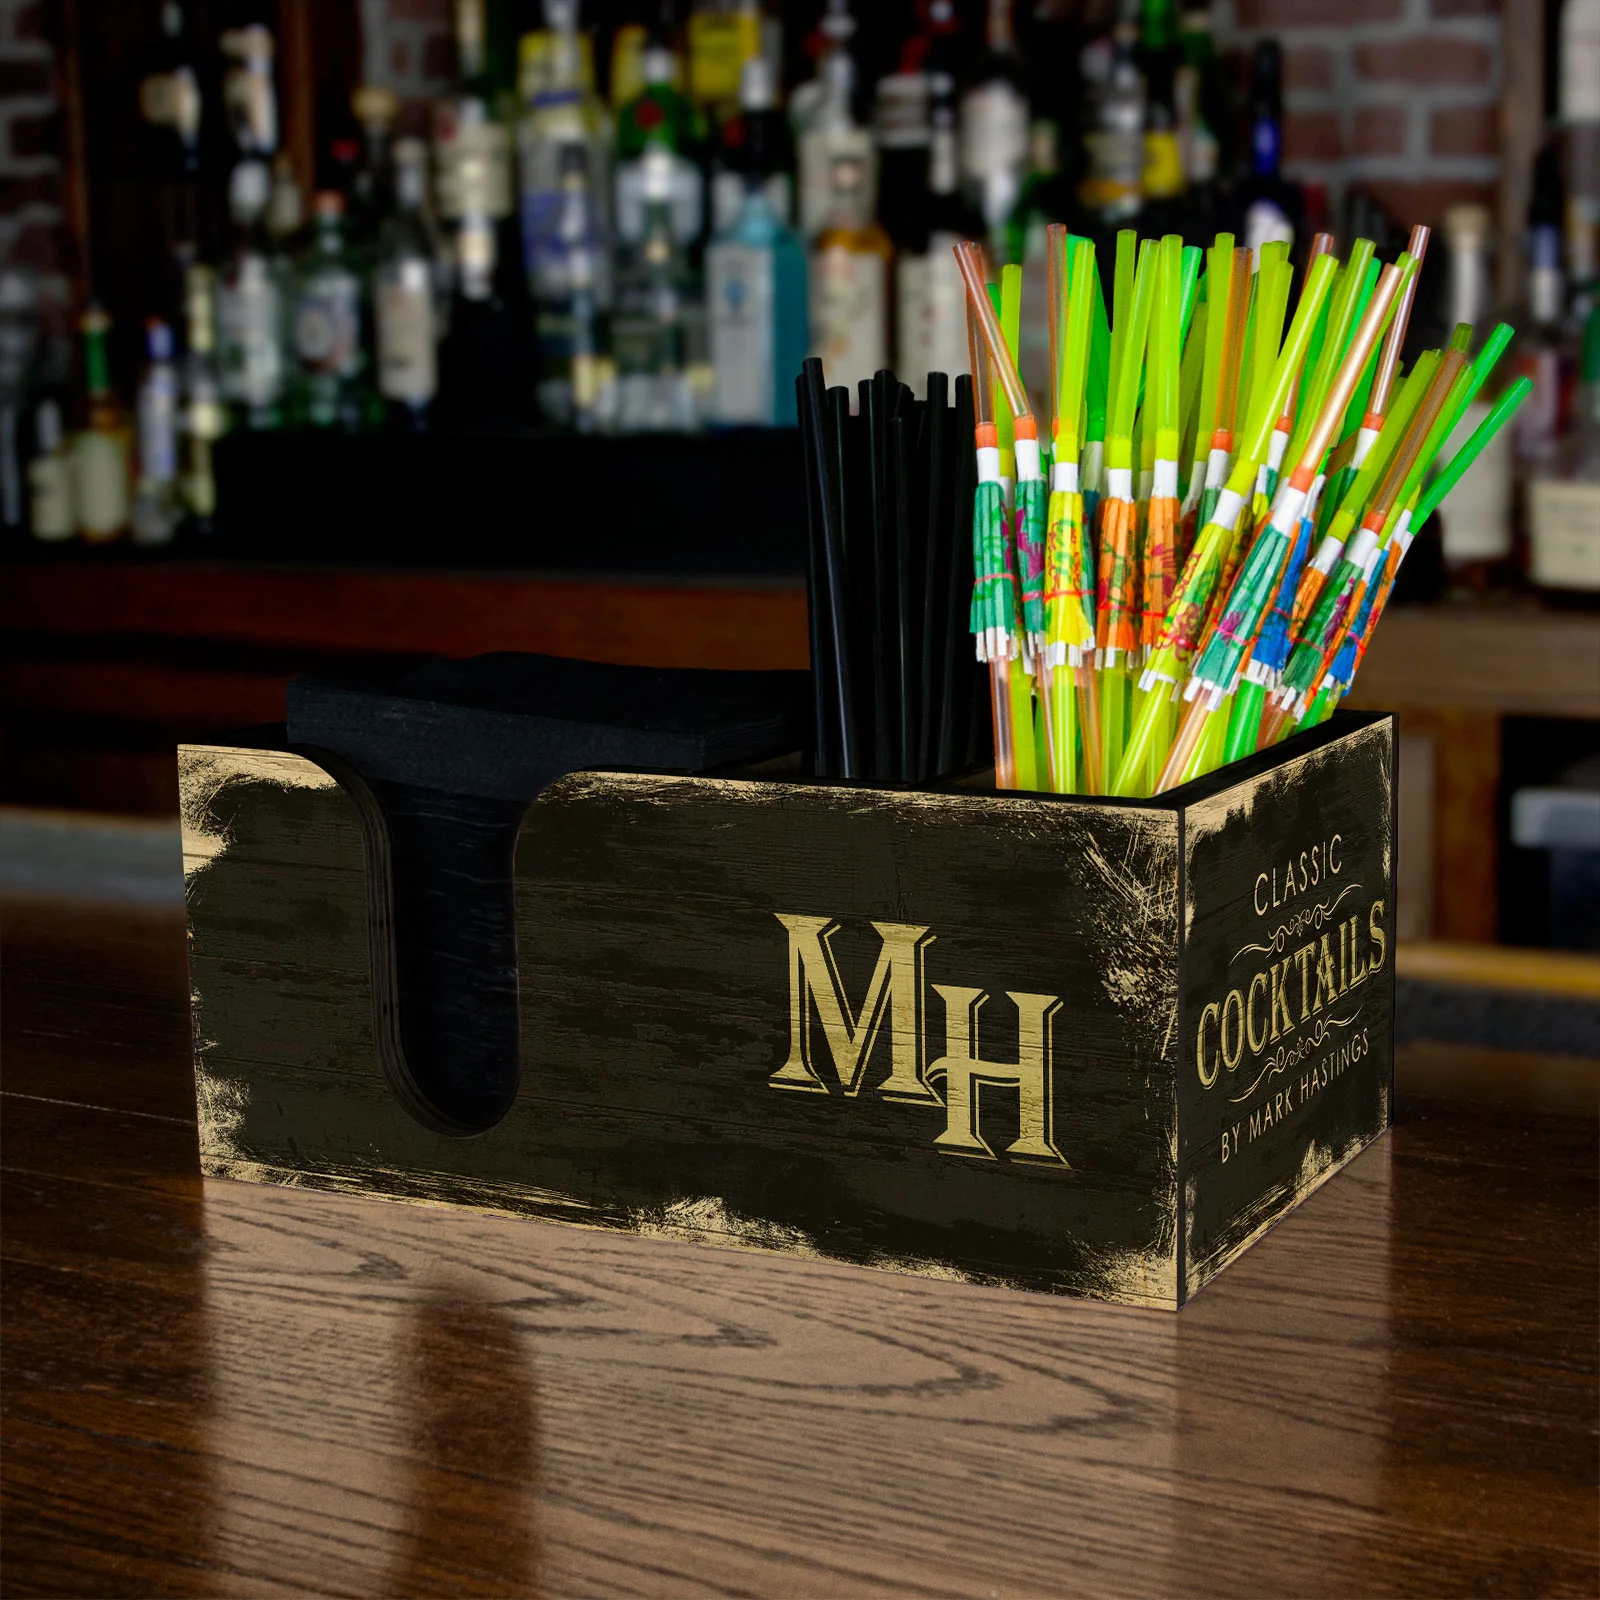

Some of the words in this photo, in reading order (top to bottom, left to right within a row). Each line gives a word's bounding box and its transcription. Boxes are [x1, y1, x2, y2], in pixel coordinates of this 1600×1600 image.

[1254, 834, 1343, 916] CLASSIC
[768, 913, 1072, 1169] MH
[1196, 899, 1387, 1090] COCKTAILS
[1221, 1122, 1240, 1164] BY
[1248, 1085, 1293, 1143] MARK
[1300, 1028, 1370, 1103] HASTINGS
